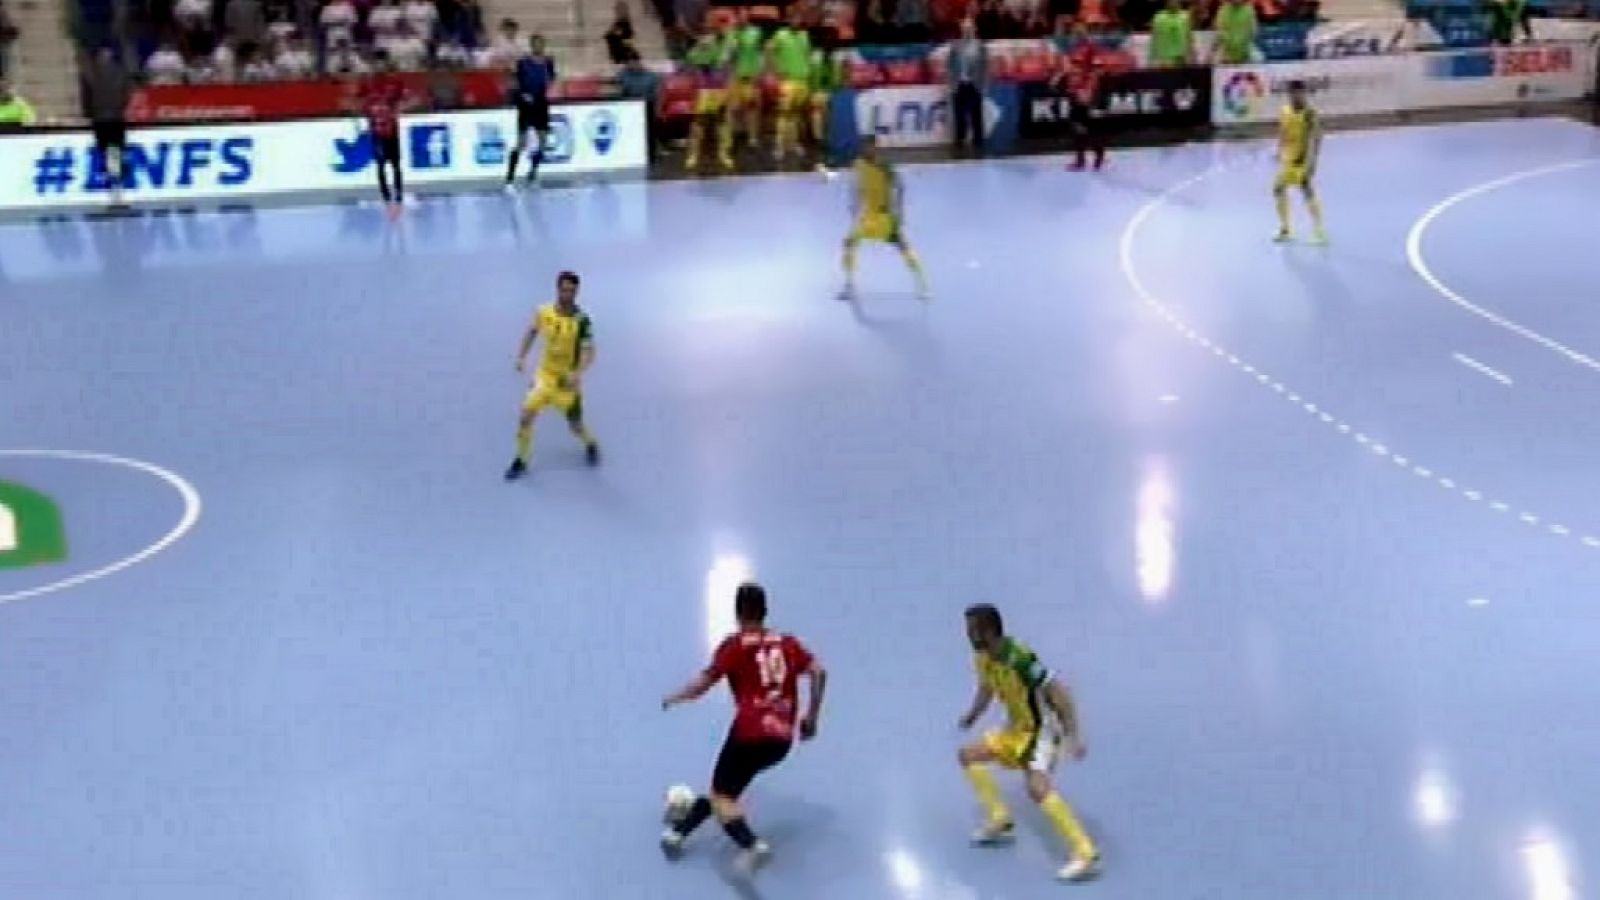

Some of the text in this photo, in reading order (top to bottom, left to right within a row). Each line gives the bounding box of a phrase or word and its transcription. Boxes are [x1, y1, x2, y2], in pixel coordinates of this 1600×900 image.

[873, 101, 949, 135] LNF
[34, 137, 254, 195] #LNFS
[755, 647, 787, 687] 10
